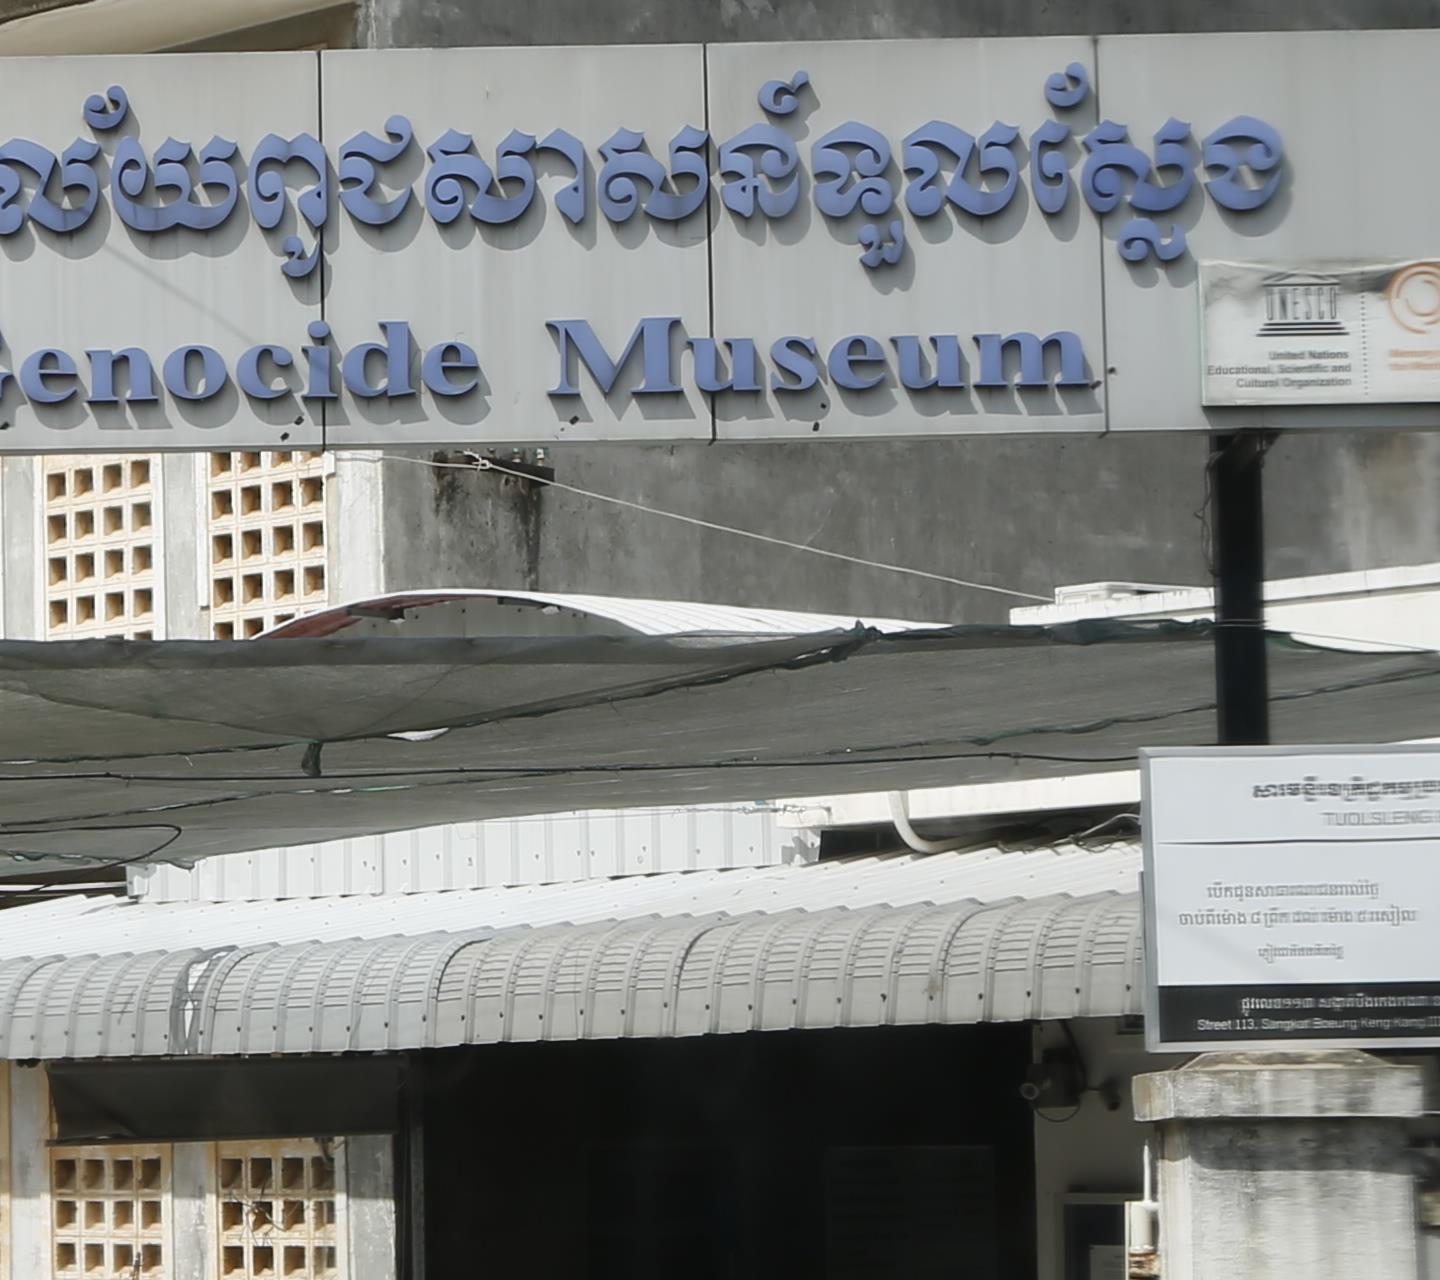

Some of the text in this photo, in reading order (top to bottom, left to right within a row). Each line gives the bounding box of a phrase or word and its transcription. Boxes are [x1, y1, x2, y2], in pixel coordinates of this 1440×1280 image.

[1265, 287, 1338, 321] UNESCO
[547, 315, 1096, 396] Museum
[1307, 349, 1350, 361] Nations
[1331, 362, 1352, 373] and
[1197, 1019, 1232, 1031] Street
